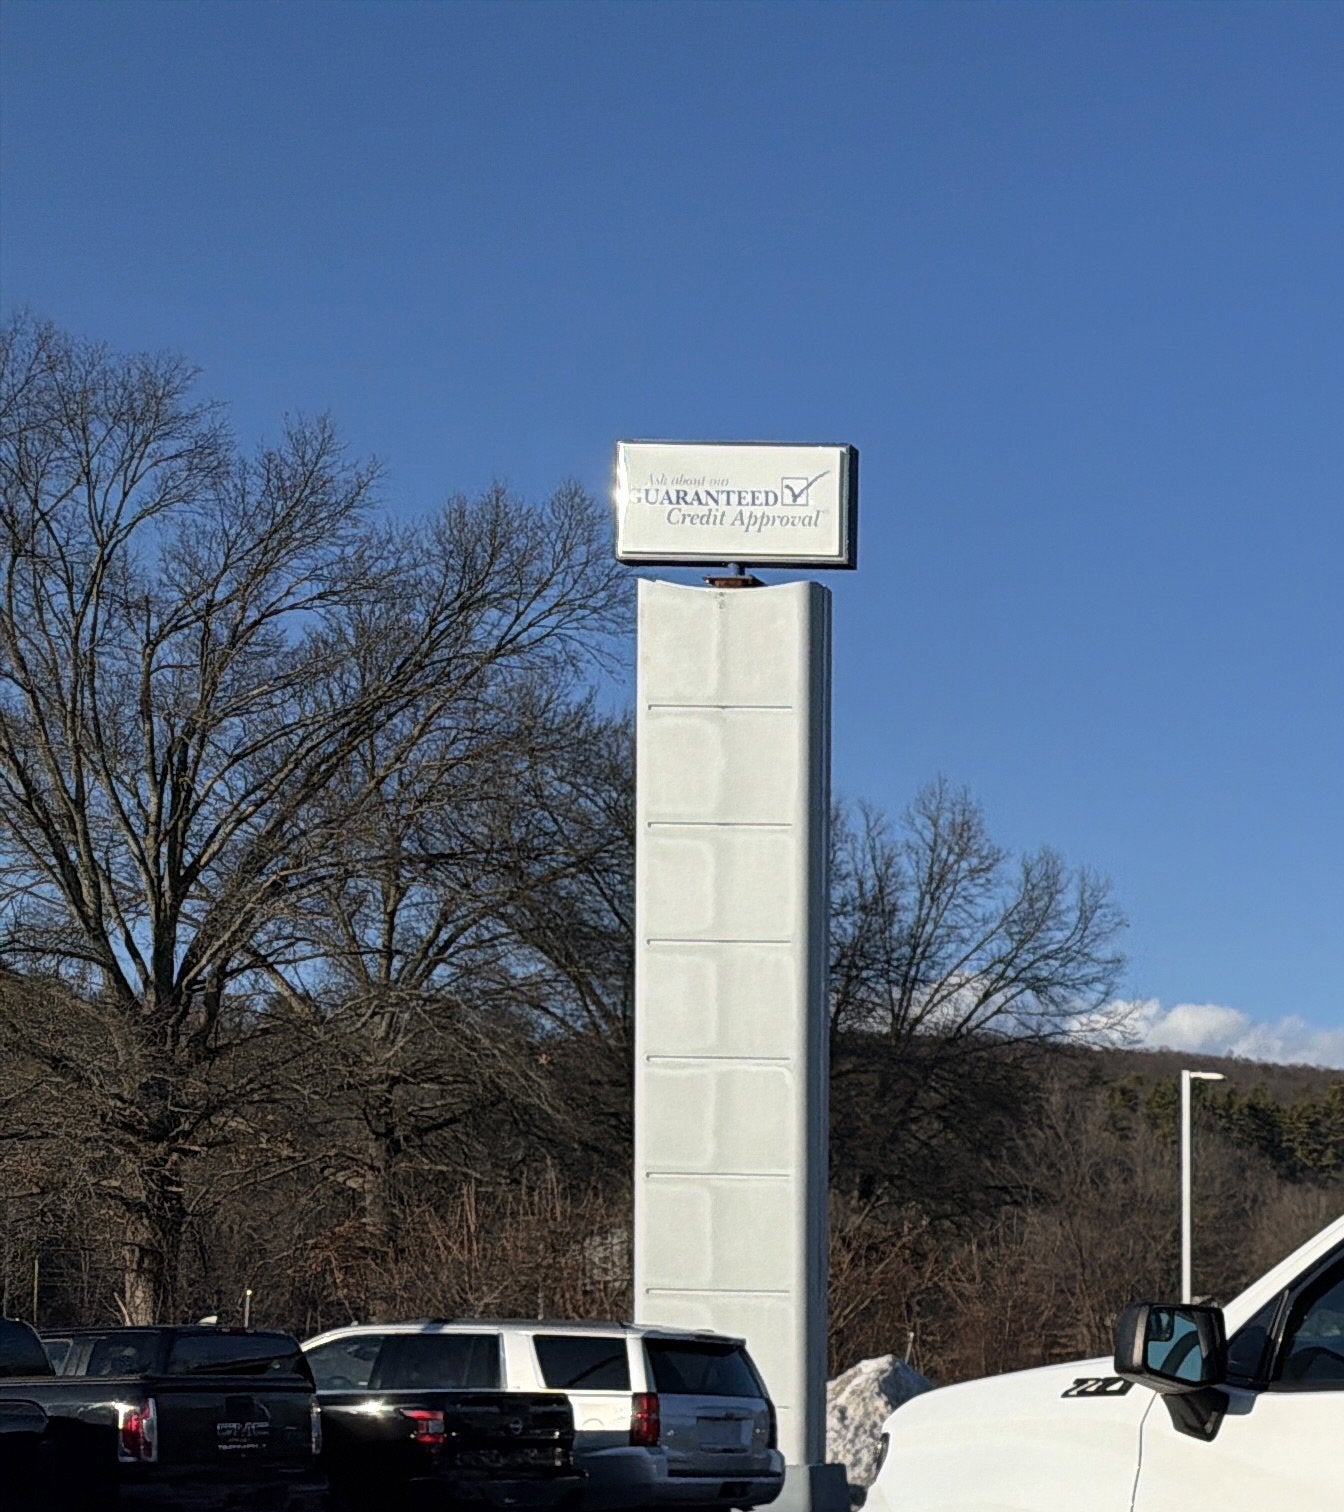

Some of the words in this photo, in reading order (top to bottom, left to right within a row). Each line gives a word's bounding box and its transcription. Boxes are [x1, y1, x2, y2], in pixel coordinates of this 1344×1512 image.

[645, 473, 668, 486] Ask
[670, 473, 706, 486] about
[630, 488, 779, 506] GUARANTEED
[666, 507, 726, 526] Credit
[731, 508, 822, 533] Approval
